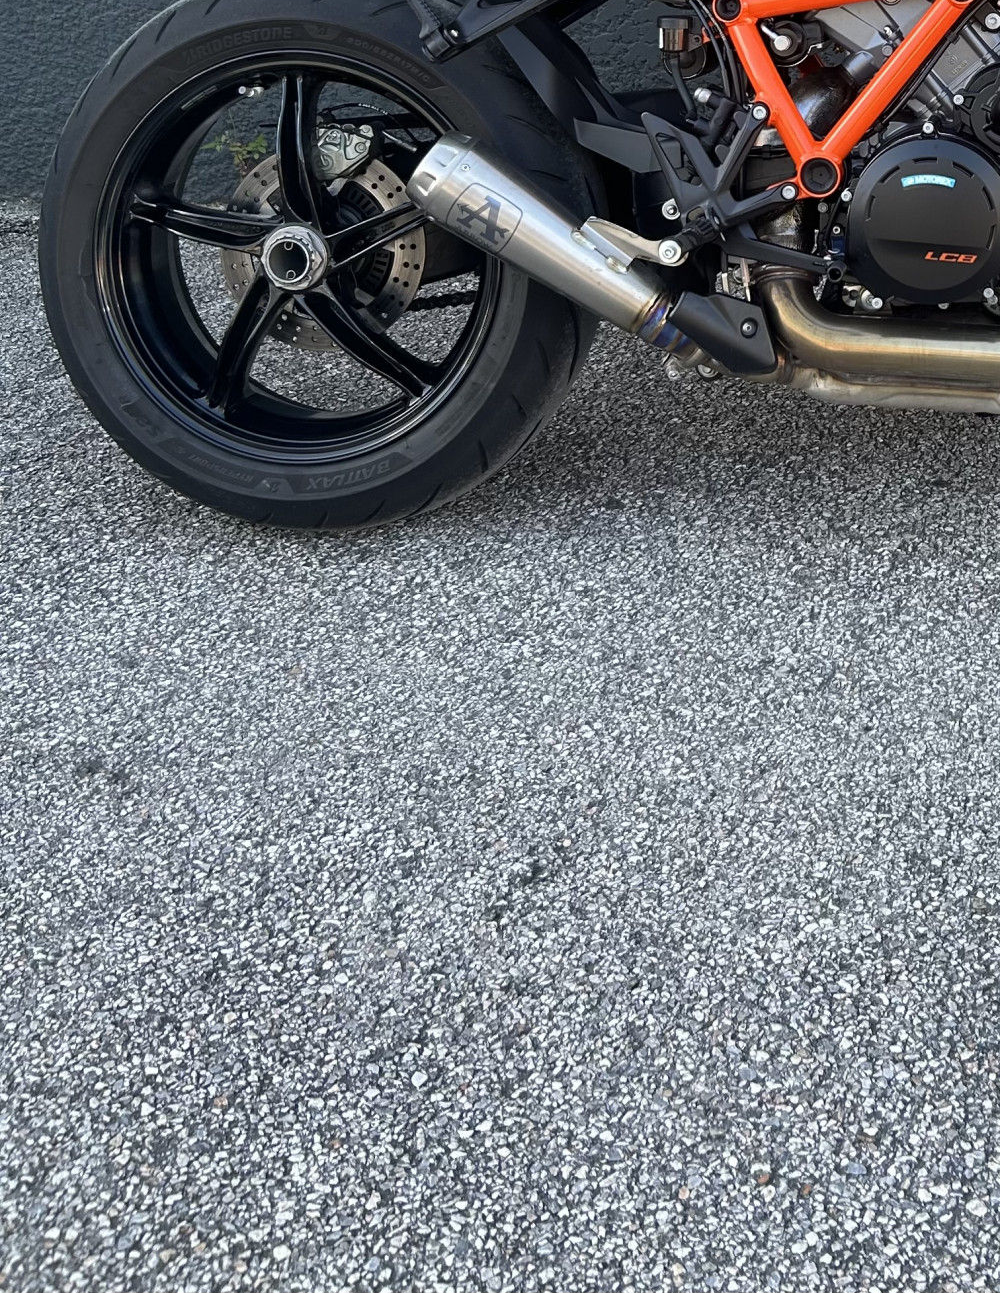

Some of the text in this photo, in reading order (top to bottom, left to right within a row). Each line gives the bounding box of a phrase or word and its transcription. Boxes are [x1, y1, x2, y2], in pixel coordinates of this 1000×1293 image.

[183, 26, 293, 64] BRIDGESTONE
[914, 175, 952, 187] MOTOREX
[925, 251, 978, 264] LC8
[306, 458, 391, 492] BATTLAX
